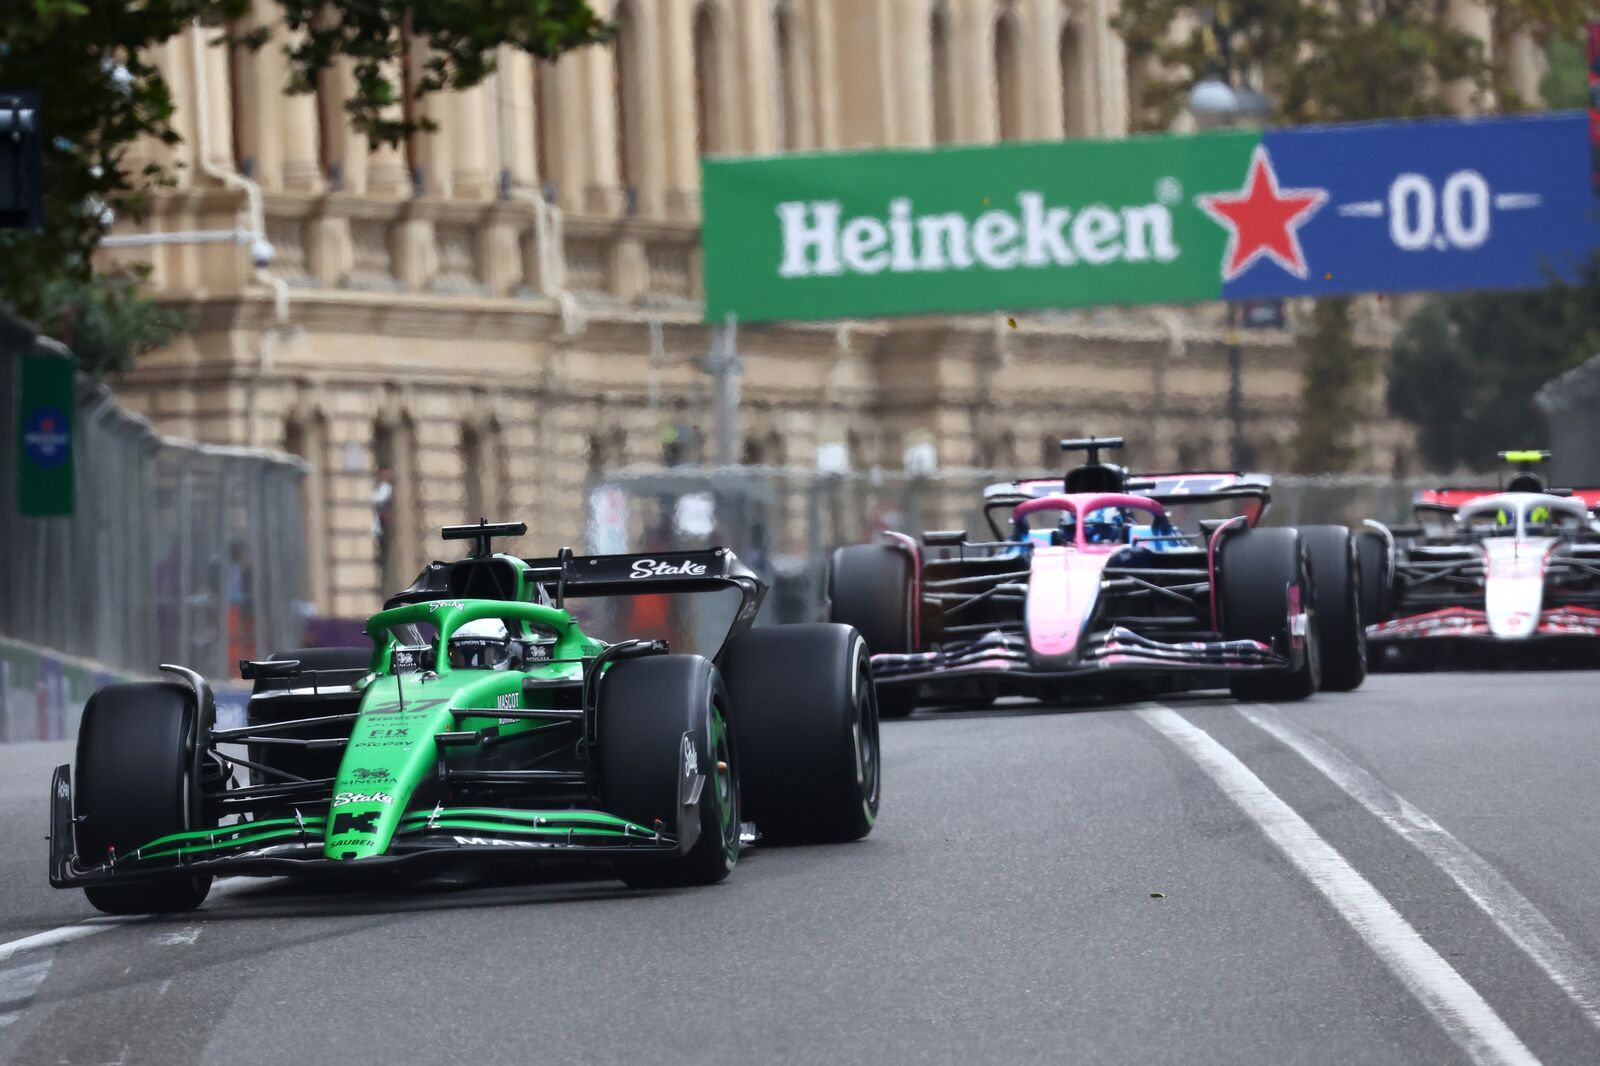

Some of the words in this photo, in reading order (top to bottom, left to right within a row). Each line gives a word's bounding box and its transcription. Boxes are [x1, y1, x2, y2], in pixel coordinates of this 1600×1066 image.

[629, 559, 707, 579] Stake
[429, 600, 465, 613] Stake
[364, 698, 450, 716] 27
[497, 692, 519, 709] MASCOT
[369, 728, 409, 737] FIX
[333, 791, 394, 808] Stake
[330, 839, 375, 849] SAUBER
